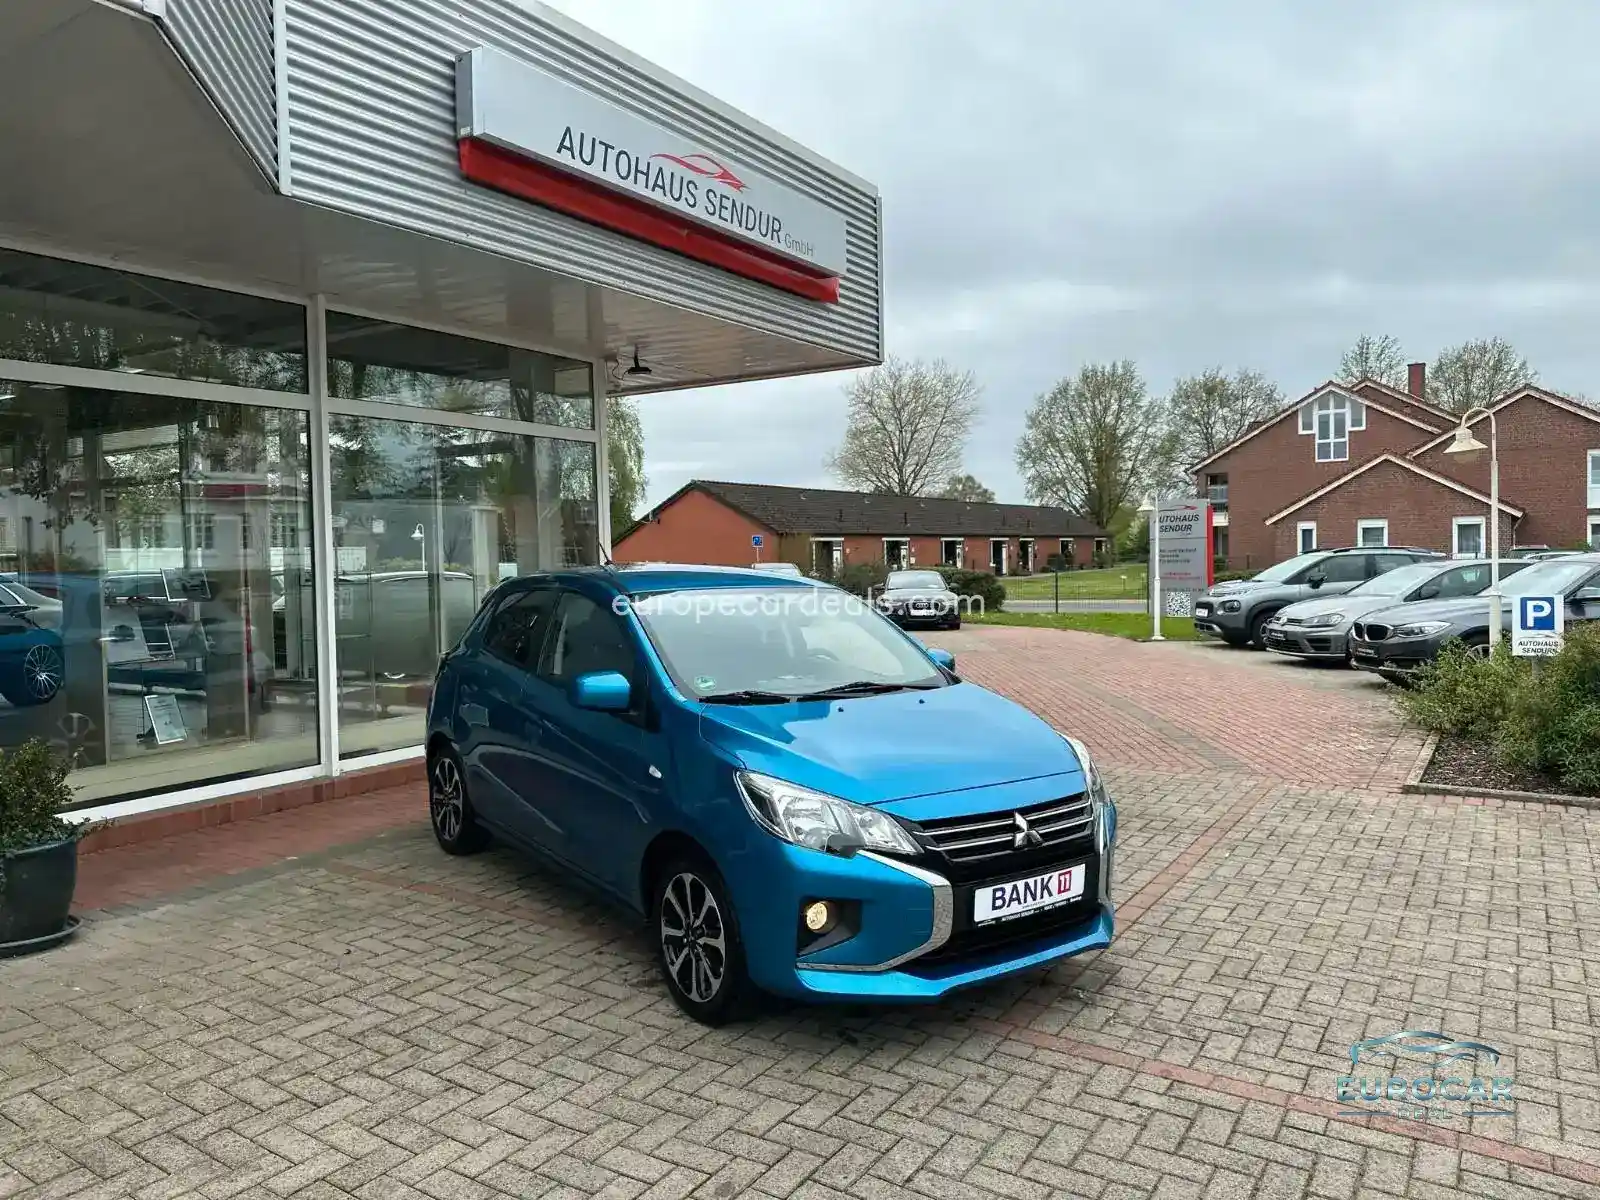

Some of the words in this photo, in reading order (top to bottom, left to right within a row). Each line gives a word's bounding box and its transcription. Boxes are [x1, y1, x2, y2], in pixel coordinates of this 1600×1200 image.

[556, 126, 698, 209] AUTOHAUS
[704, 188, 783, 244] SENDUR
[784, 232, 815, 257] GmbH
[1154, 514, 1200, 524] UTOHAUS
[1159, 524, 1193, 533] SENDUR
[1526, 600, 1552, 628] P
[991, 875, 1054, 911] BANK
